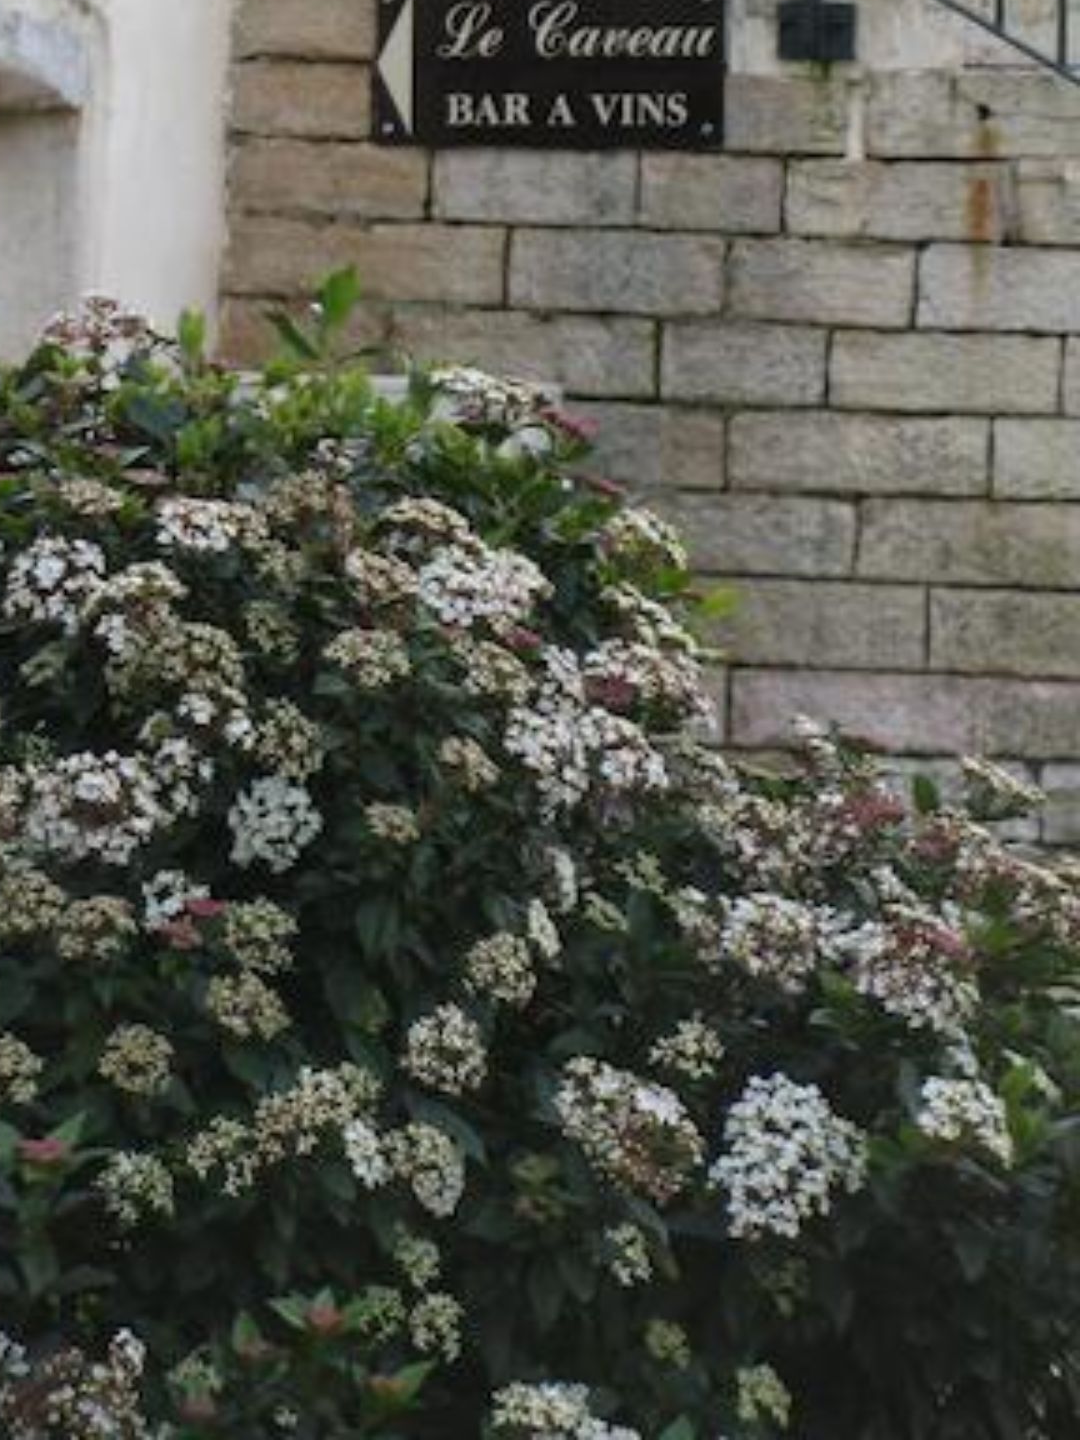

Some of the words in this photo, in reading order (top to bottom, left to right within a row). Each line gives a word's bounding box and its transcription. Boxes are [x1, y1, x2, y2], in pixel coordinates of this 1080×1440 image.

[436, 0, 504, 59] Le
[527, 0, 717, 59] Caveau
[446, 92, 531, 127] BAR
[546, 92, 576, 126] A
[590, 92, 689, 127] VINS
